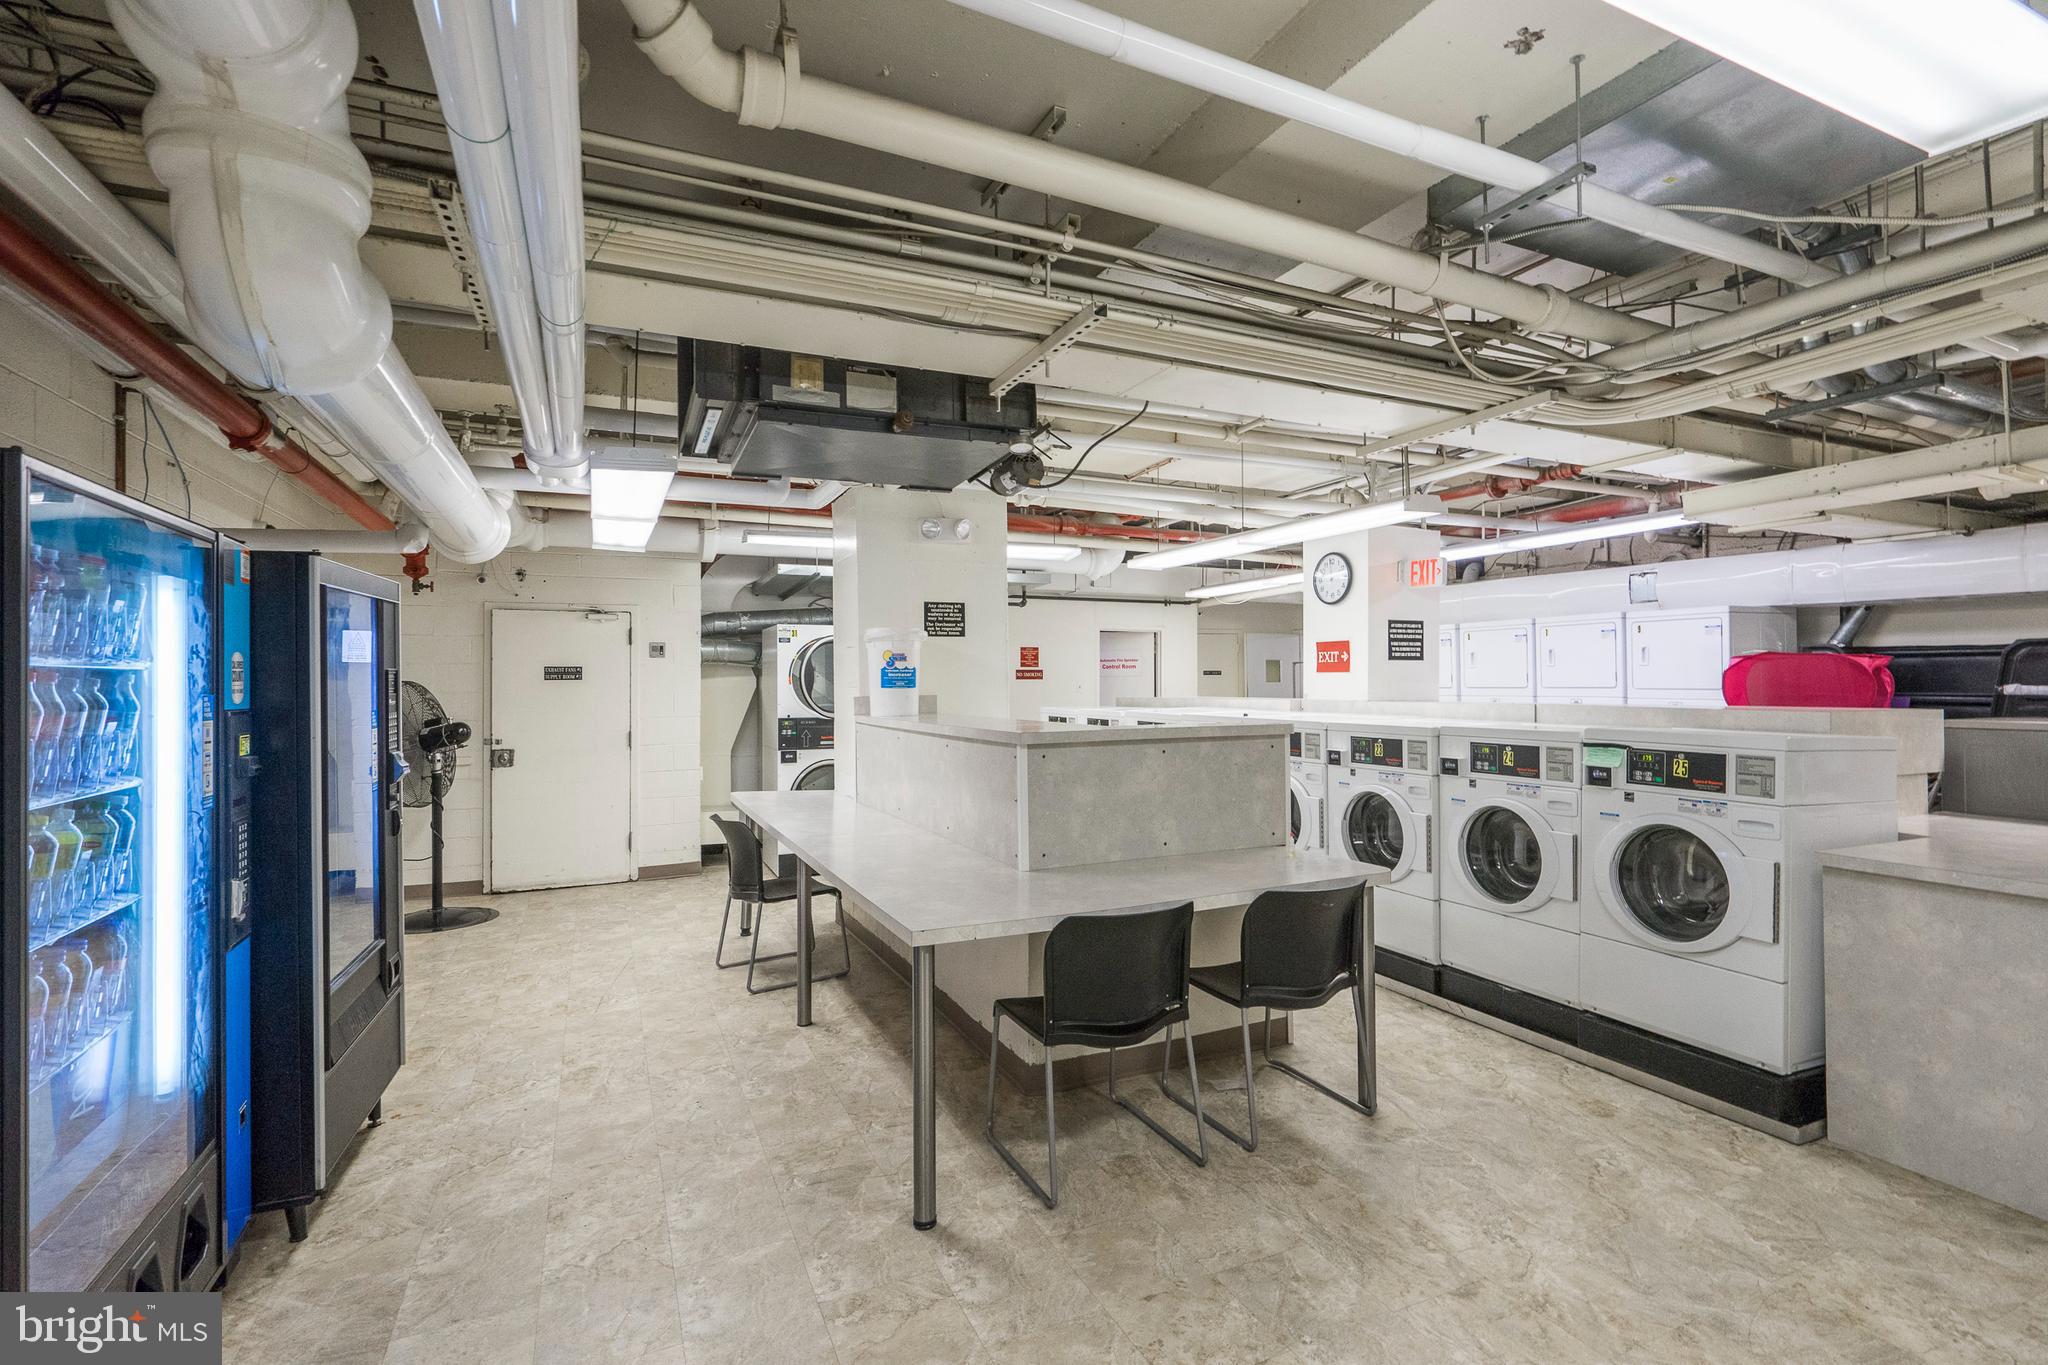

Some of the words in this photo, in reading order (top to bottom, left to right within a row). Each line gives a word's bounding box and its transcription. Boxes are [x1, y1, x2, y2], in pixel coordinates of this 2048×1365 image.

[1410, 559, 1438, 586] EXIT
[1319, 651, 1339, 662] EXIT
[1504, 751, 1513, 765] 24
[1674, 760, 1688, 776] 25
